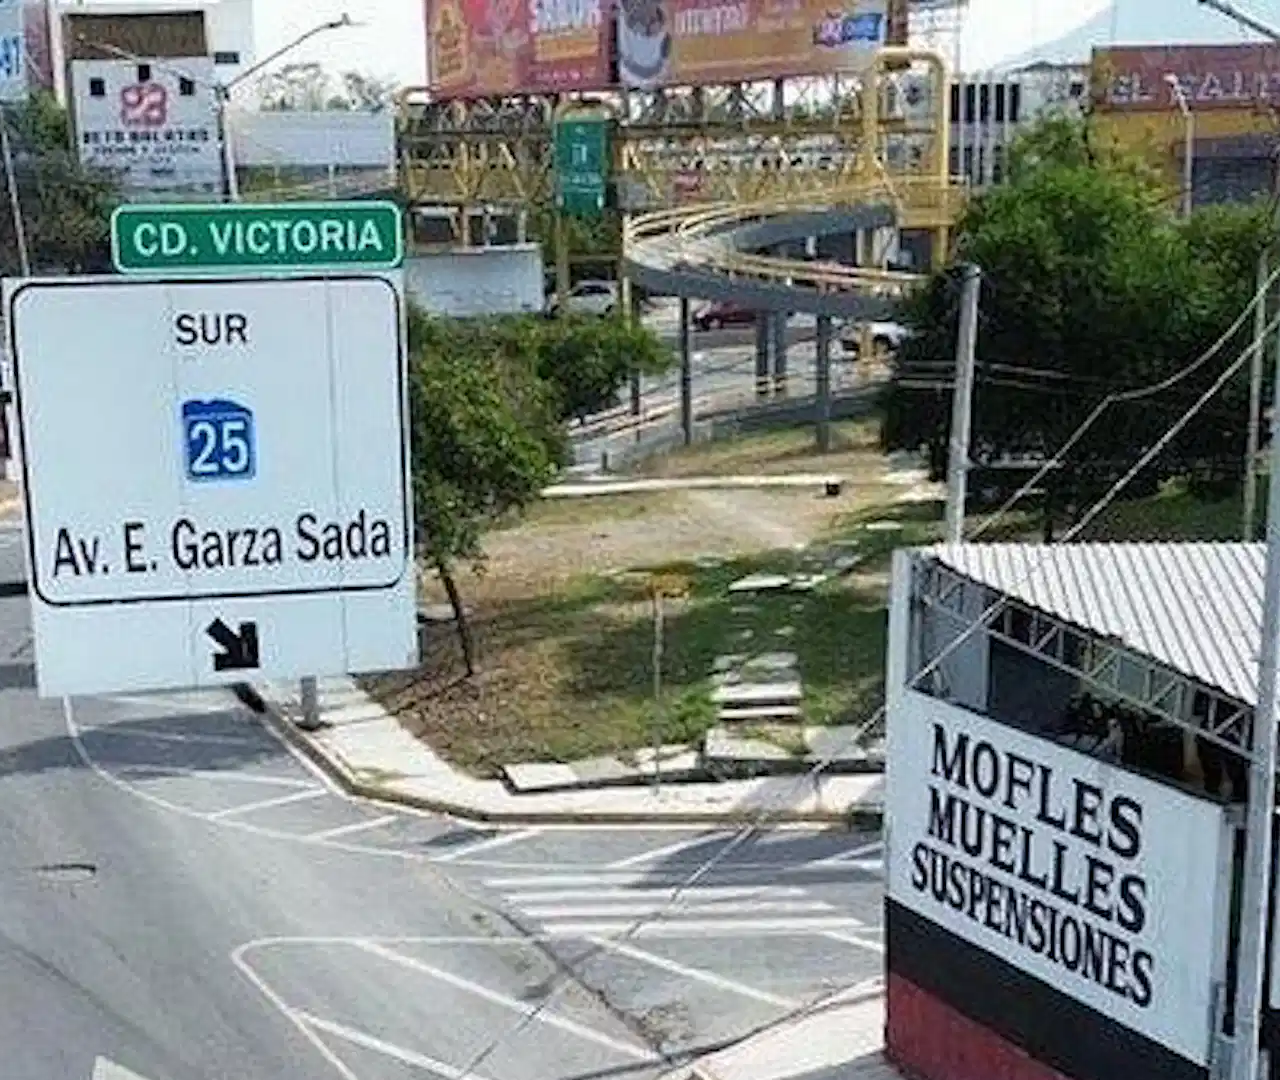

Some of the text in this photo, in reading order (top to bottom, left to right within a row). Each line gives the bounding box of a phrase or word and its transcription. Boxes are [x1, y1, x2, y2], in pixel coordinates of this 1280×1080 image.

[133, 218, 384, 256] CD. VICTORIA
[176, 313, 248, 345] SUR
[189, 418, 250, 474] 25
[53, 509, 391, 577] Av. E. Garza Sada
[930, 722, 1143, 859] MOFLES
[927, 787, 1147, 934] MUELLES
[910, 843, 1154, 1009] SUSPENSIONES
